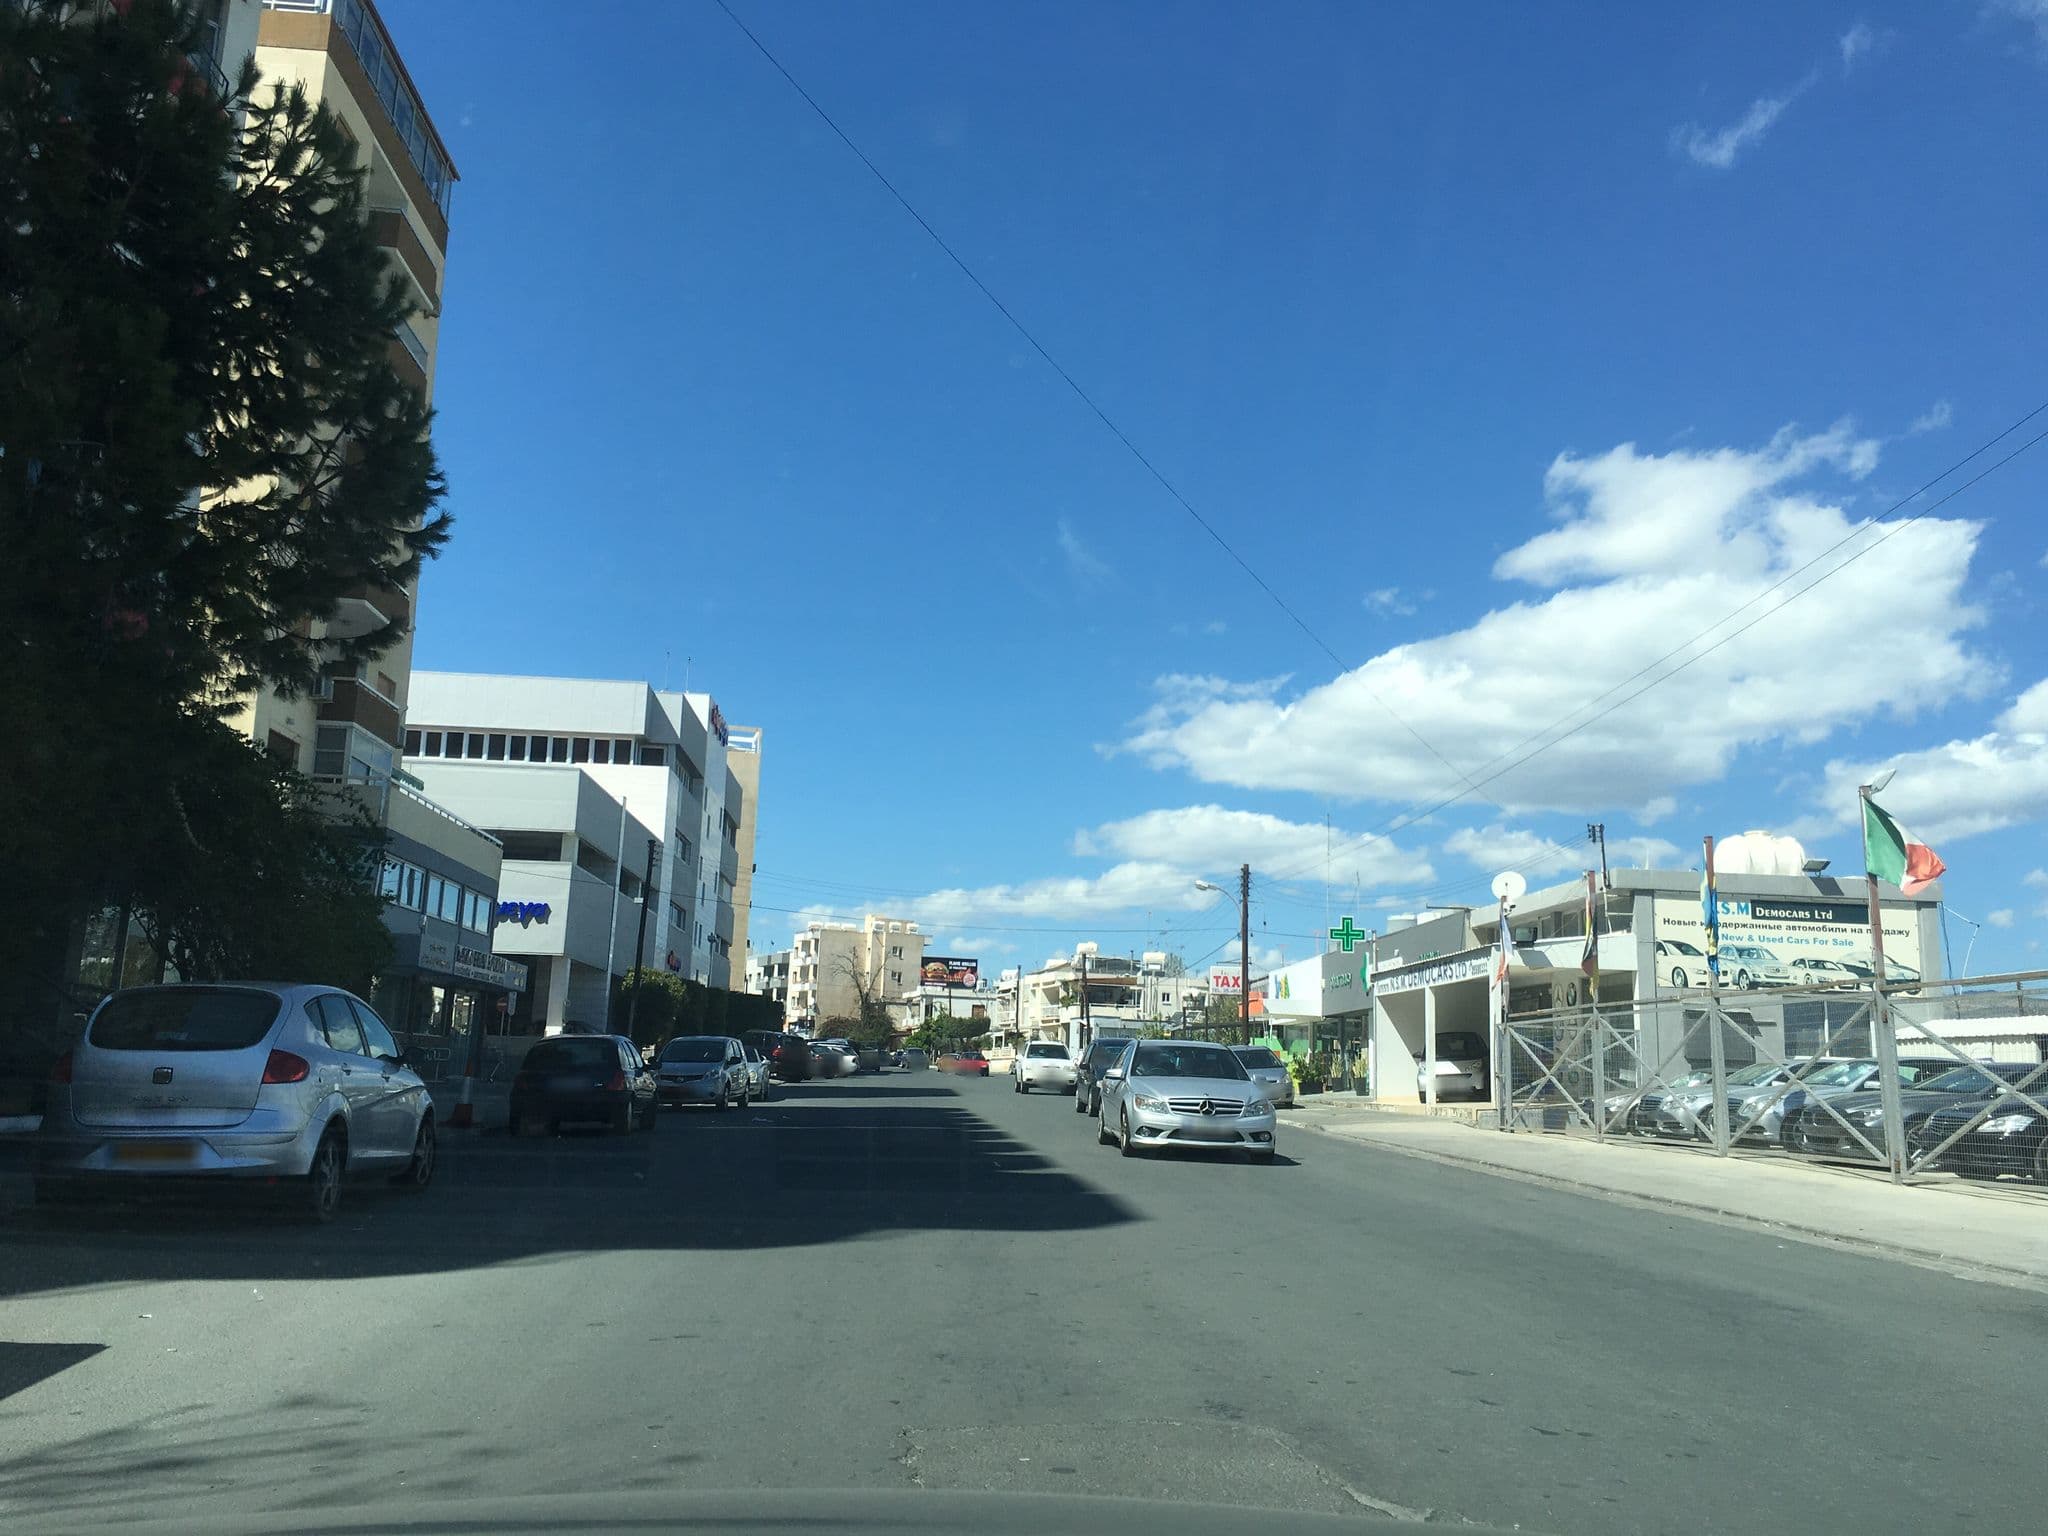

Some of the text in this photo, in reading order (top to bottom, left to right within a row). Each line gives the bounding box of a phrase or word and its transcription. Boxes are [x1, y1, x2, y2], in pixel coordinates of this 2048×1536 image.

[1663, 918, 1697, 927] Новые
[1717, 922, 1782, 931] одержанные
[1785, 925, 1847, 935] автомобили
[1866, 929, 1910, 938] подажу
[1721, 933, 1855, 947] New & Used Cars For Sale
[1408, 961, 1454, 988] DEMOCARS
